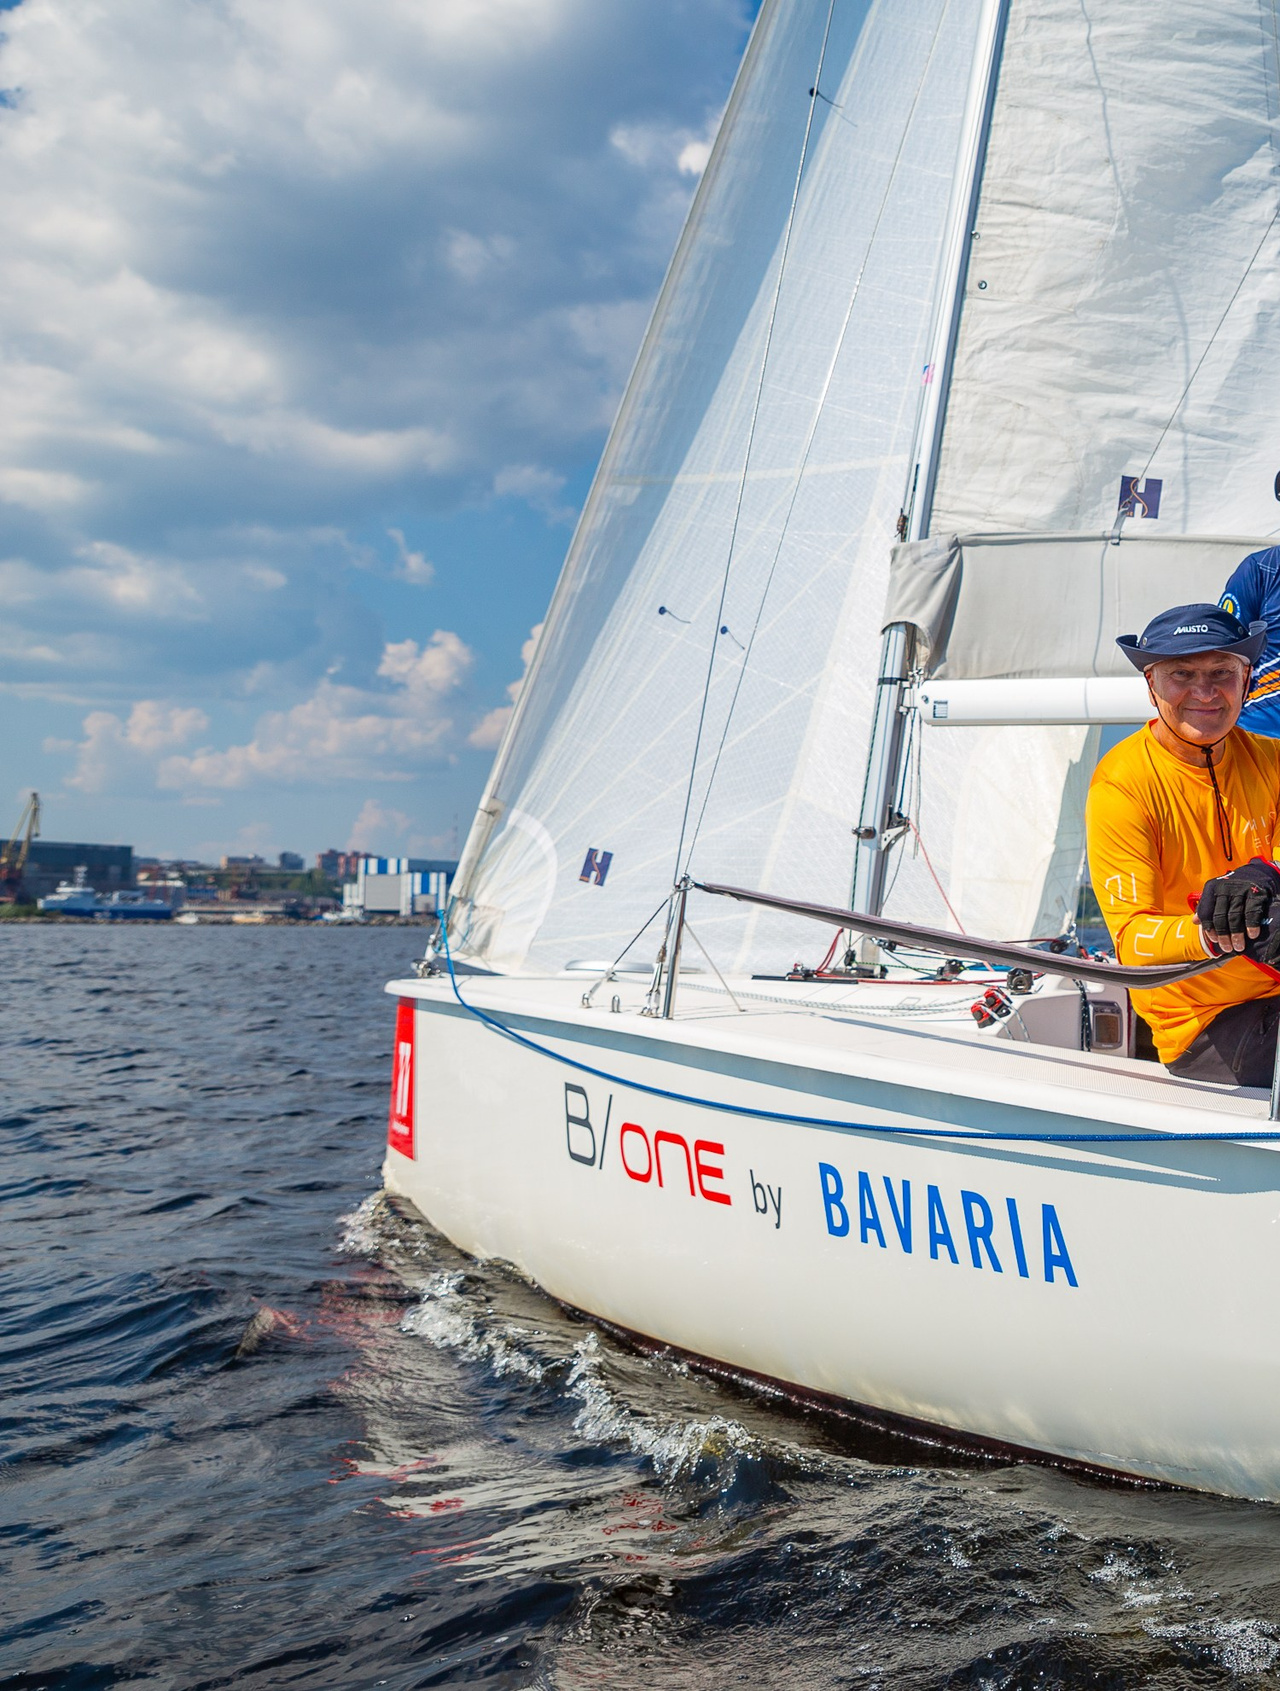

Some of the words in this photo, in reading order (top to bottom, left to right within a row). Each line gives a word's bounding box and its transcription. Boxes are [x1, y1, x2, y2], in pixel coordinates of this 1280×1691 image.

[1173, 624, 1209, 636] MUSTO
[750, 1169, 781, 1229] by
[818, 1162, 1079, 1288] BAVARIA
